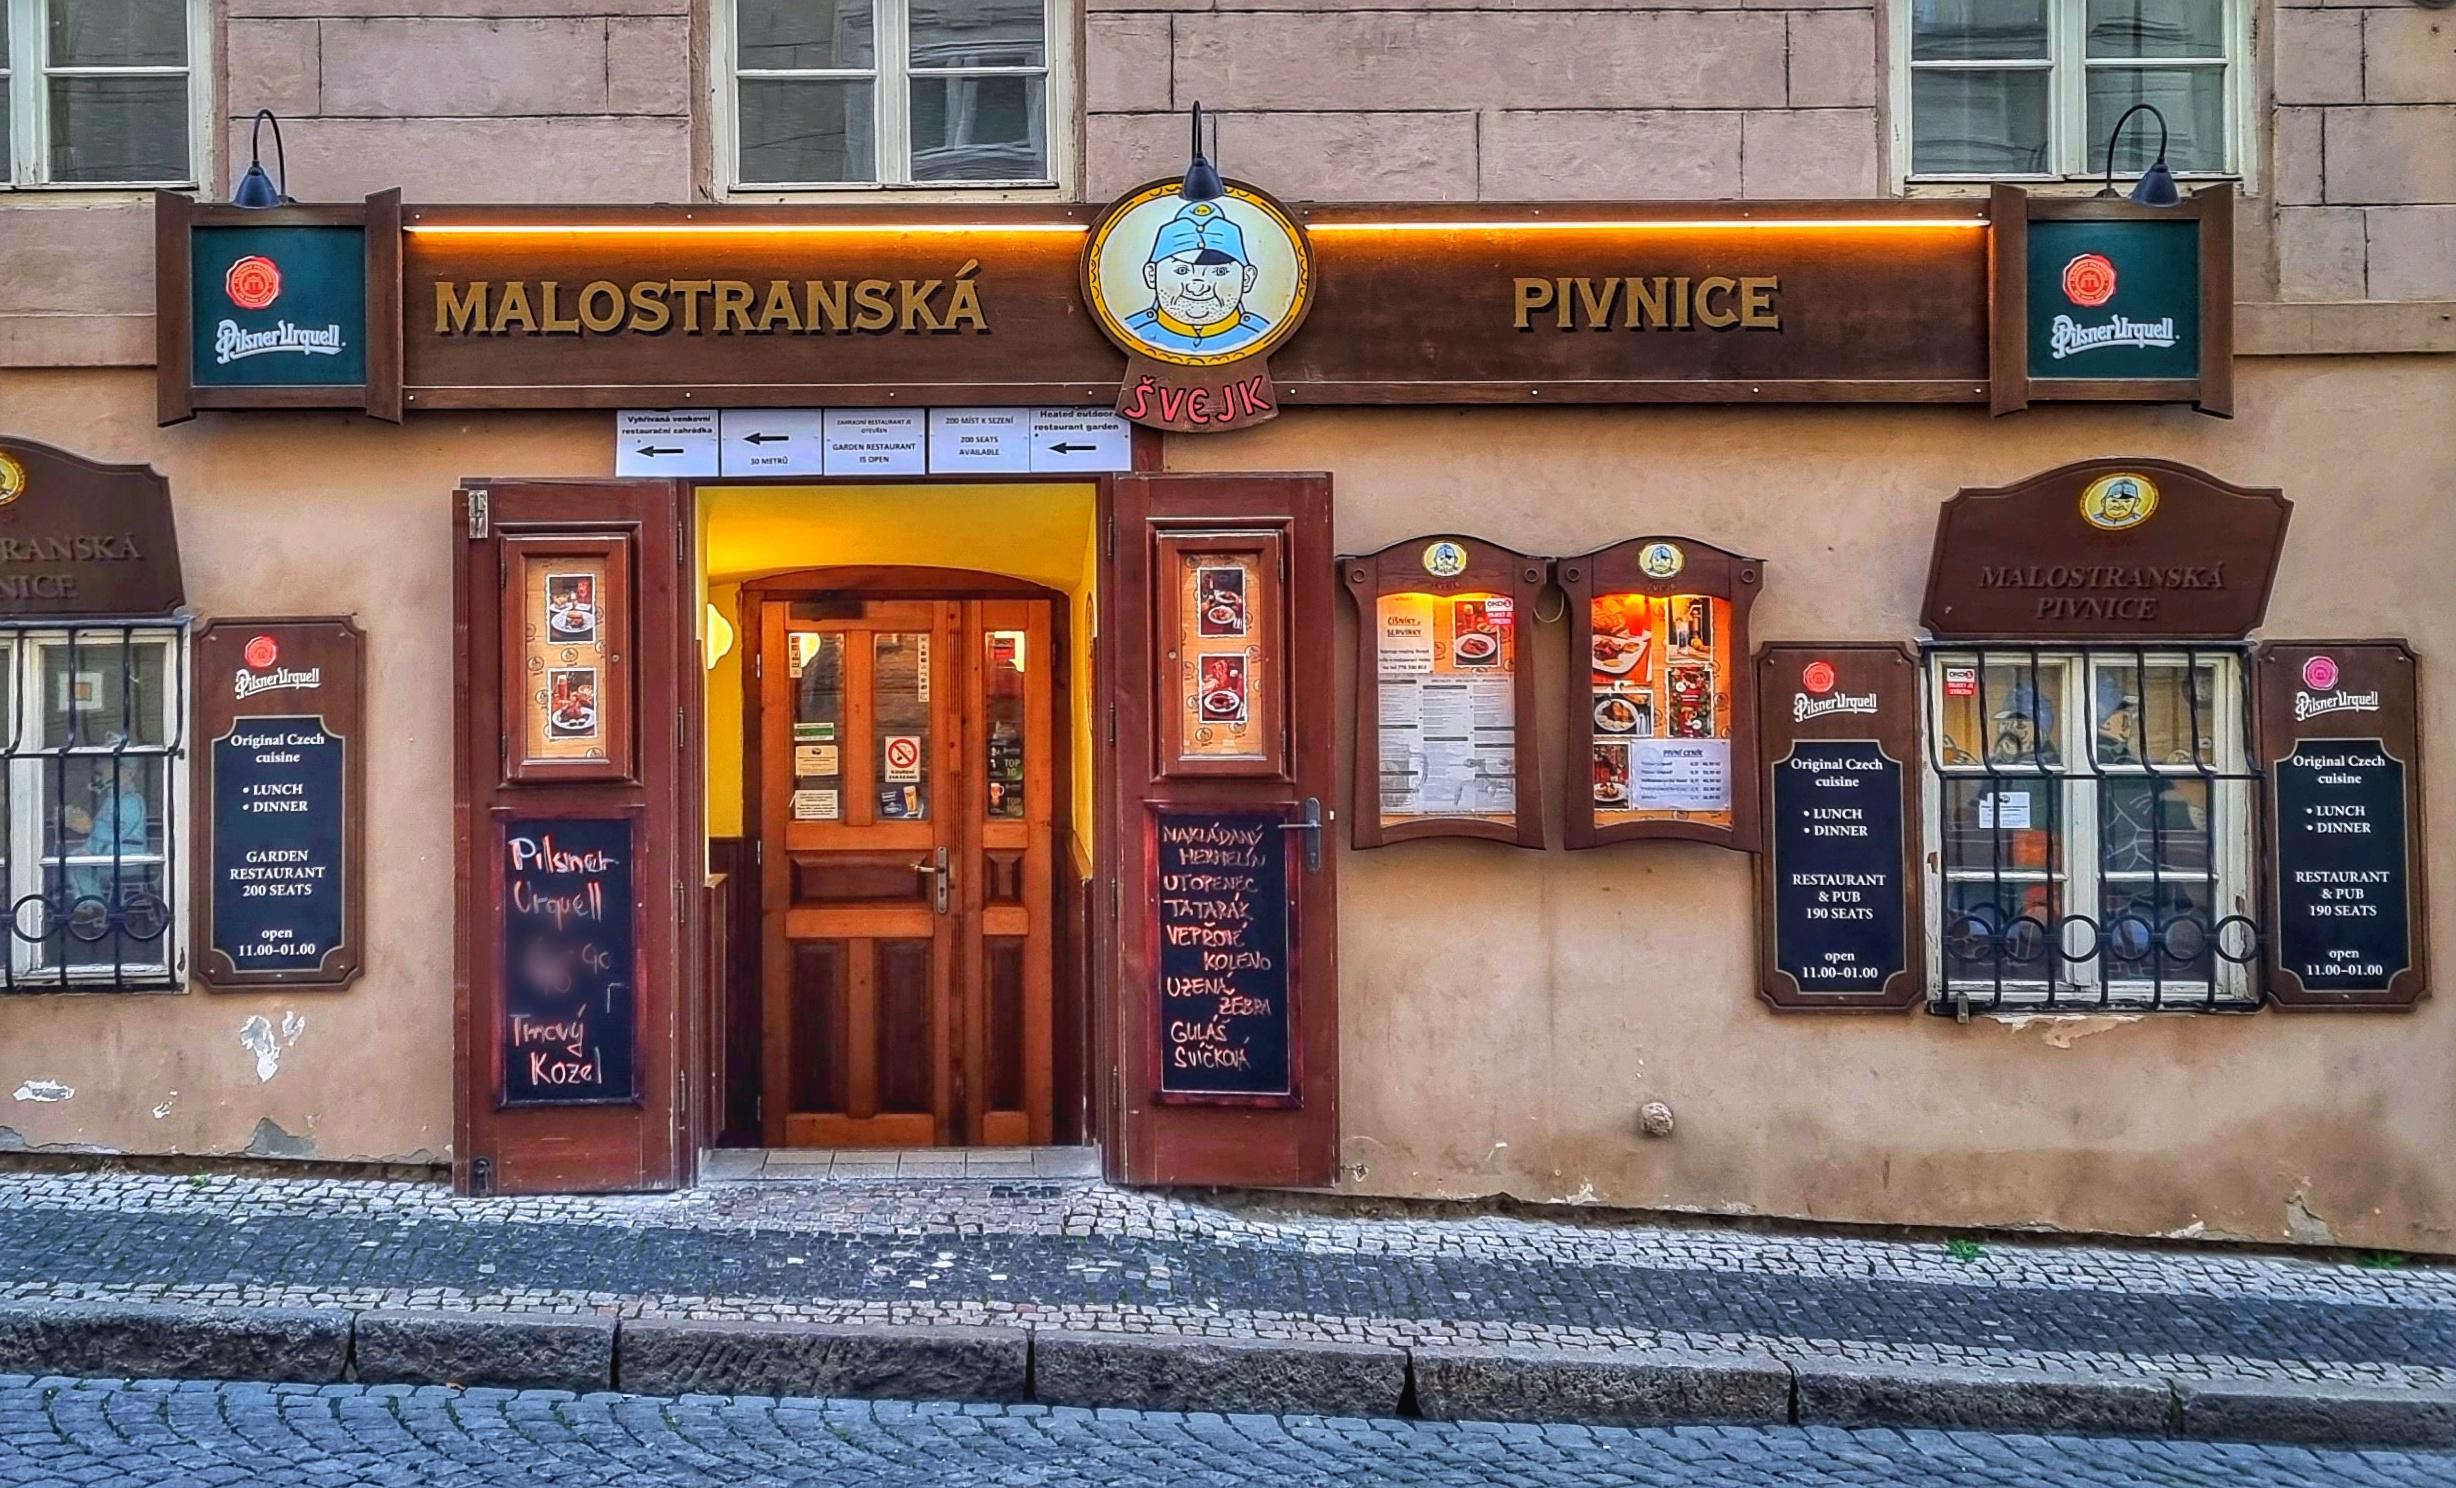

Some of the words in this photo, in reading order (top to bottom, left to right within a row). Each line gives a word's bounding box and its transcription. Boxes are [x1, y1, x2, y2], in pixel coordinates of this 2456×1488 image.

[433, 258, 989, 333] MALOSTRANSKÁ
[1513, 275, 1779, 330] PIVNICE
[215, 319, 280, 364] Pilsner
[277, 319, 342, 355] Urquell
[2051, 314, 2115, 359] Pilsner
[2110, 313, 2176, 348] Urquell
[1123, 375, 1273, 423] ŠVEJK
[961, 416, 980, 424] MÍST
[988, 416, 1014, 424] SEZENÍ
[1040, 410, 1074, 418] Heated
[1077, 410, 1112, 418] outdoor
[1087, 424, 1119, 432] garden
[866, 442, 916, 450] RESTAURANT
[959, 448, 1000, 456] AVAILABLE
[1980, 562, 2225, 589] MALOSTRANSKÁ
[2036, 598, 2158, 620] PIVNICE
[235, 668, 280, 700] Pilsner
[277, 668, 321, 689] Urquell
[1793, 693, 1838, 722] Pilsner
[1834, 692, 1879, 714] Urquell
[2295, 691, 2340, 722] Pilsner
[2336, 690, 2380, 712] Urquell
[231, 734, 284, 748] Original
[287, 733, 324, 745] Czech
[256, 752, 300, 763] cuisine
[2293, 755, 2345, 770] Original
[2347, 755, 2386, 767] Czech
[1791, 758, 1843, 773] Original
[1846, 758, 1883, 770] Czech
[1815, 776, 1859, 787] cuisine
[2317, 773, 2362, 784] cuisine
[253, 784, 303, 795] LUNCH
[253, 801, 308, 812] DINNER
[2316, 806, 2365, 816] LUNCH
[1813, 809, 1862, 819] LUNCH
[1814, 826, 1868, 837] DINNER
[2317, 823, 2371, 833] DINNER
[246, 850, 309, 862] GARDEN
[230, 867, 326, 880] RESTAURANT
[2296, 871, 2390, 883] RESTAURANT
[1163, 873, 1259, 893] UTOPENEC
[1792, 874, 1886, 886] RESTAURANT
[242, 885, 267, 897] 200
[269, 884, 312, 896] SEATS
[2321, 889, 2332, 900] &
[2336, 888, 2364, 899] PUB
[1818, 892, 1829, 903] &
[1832, 892, 1861, 902] PUB
[514, 880, 602, 932] Urquell
[2310, 906, 2331, 916] 190
[2335, 906, 2377, 916] SEATS
[1807, 908, 1829, 919] 190
[1831, 908, 1873, 919] SEATS
[261, 930, 293, 941] open
[1204, 951, 1272, 971] KOLENO
[1824, 953, 1855, 964] open
[2329, 950, 2359, 961] open
[531, 1046, 602, 1086] Kozel
